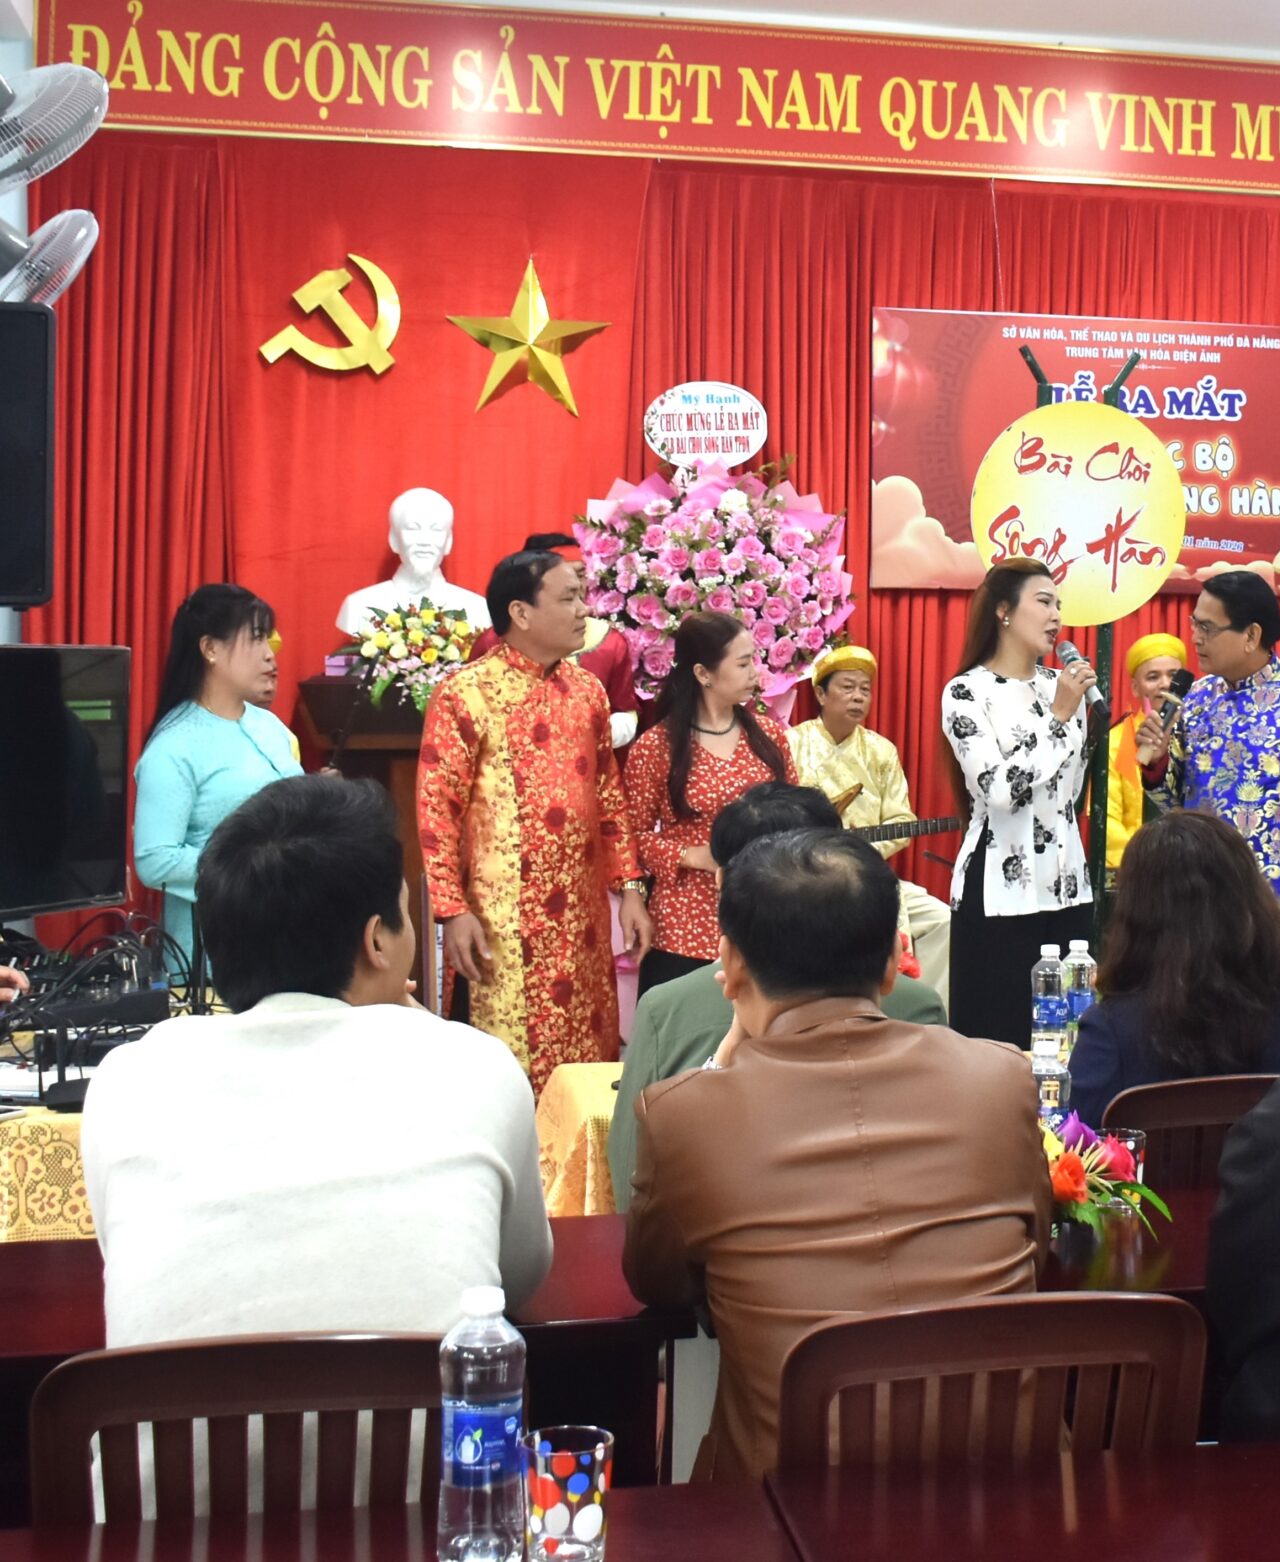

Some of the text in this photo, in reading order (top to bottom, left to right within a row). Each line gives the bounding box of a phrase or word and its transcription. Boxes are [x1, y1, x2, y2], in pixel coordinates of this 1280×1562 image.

[67, 0, 244, 98] ĐẢNG
[263, 22, 433, 120] CỘNG
[451, 25, 570, 117] SẢN
[585, 43, 722, 140] VIỆT
[736, 67, 863, 134] NAM
[879, 76, 1070, 151] QUANG
[1085, 91, 1216, 158] VINH
[1002, 325, 1017, 338] SỞ
[1019, 326, 1041, 339] VĂN
[1070, 326, 1089, 341] THẾ
[1092, 330, 1118, 342] THAO
[1120, 329, 1134, 343] VÀ
[1136, 332, 1150, 343] DU
[1153, 332, 1175, 346] LỊCH
[1178, 333, 1211, 346] THÀNH
[1213, 333, 1234, 347] PHỐ
[1065, 346, 1099, 359] TRUNG
[1102, 346, 1123, 359] TÂM
[1126, 346, 1147, 359] VN
[1172, 349, 1197, 364] ĐIỆN
[1199, 348, 1221, 363] ẢNH
[1164, 375, 1246, 420] MẮT
[728, 412, 739, 431] RA
[1193, 435, 1235, 479] BỘ
